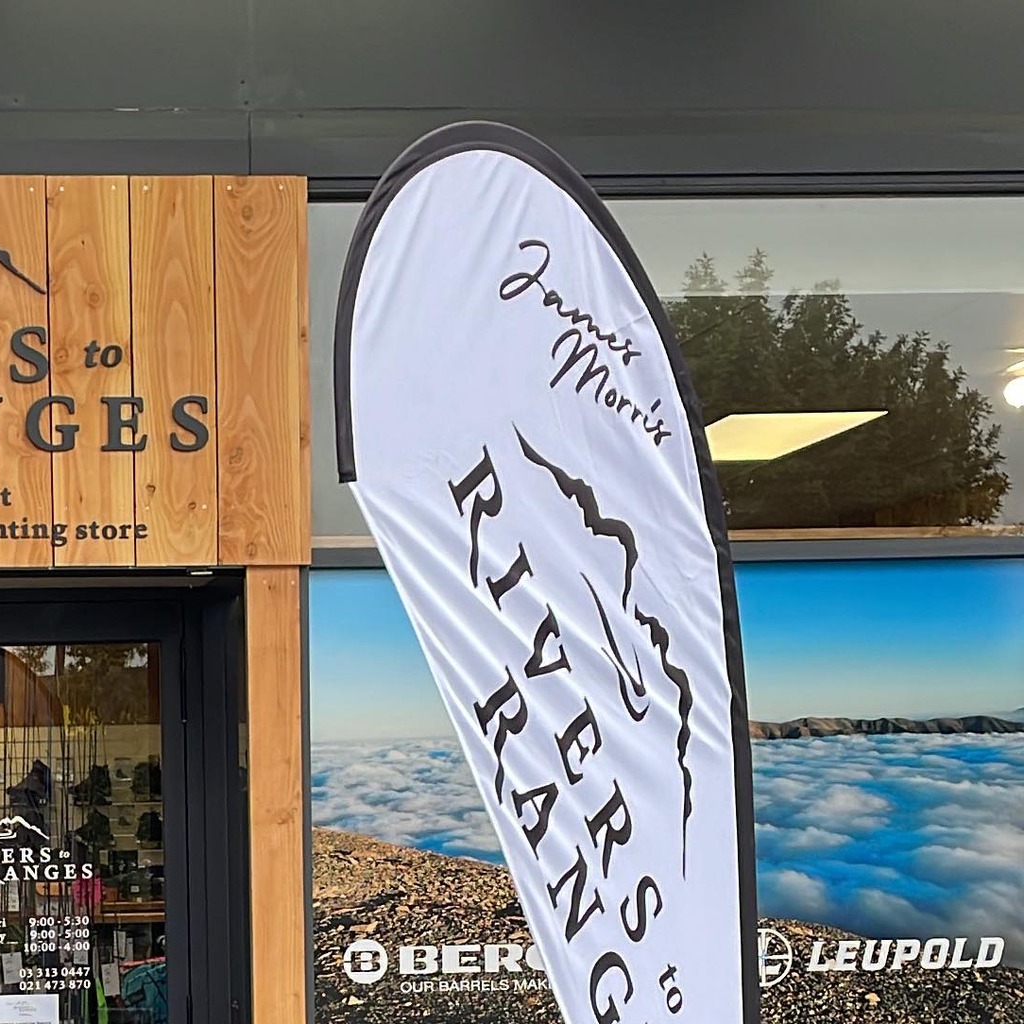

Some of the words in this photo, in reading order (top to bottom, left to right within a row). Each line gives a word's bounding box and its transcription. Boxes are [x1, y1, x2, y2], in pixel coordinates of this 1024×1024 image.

[499, 239, 641, 366] James
[84, 340, 123, 368] to
[549, 328, 672, 447] Morris
[75, 520, 148, 541] store
[448, 444, 664, 943] RIVERS
[658, 962, 683, 1015] to
[59, 850, 70, 859] to
[29, 917, 55, 928] 9:00
[63, 916, 90, 926] 5:30
[30, 930, 56, 940] 9:00
[64, 928, 90, 939] 5:00
[24, 942, 56, 952] 10:00
[63, 941, 90, 951] 4:00
[806, 936, 1005, 972] LEUPOLD
[19, 968, 34, 979] 03
[36, 967, 58, 978] 313
[61, 966, 91, 978] 0447
[19, 981, 40, 992] 021
[44, 980, 66, 990] 473
[69, 979, 91, 990] 870
[400, 981, 435, 993] OUR
[439, 979, 510, 992] BARRELS
